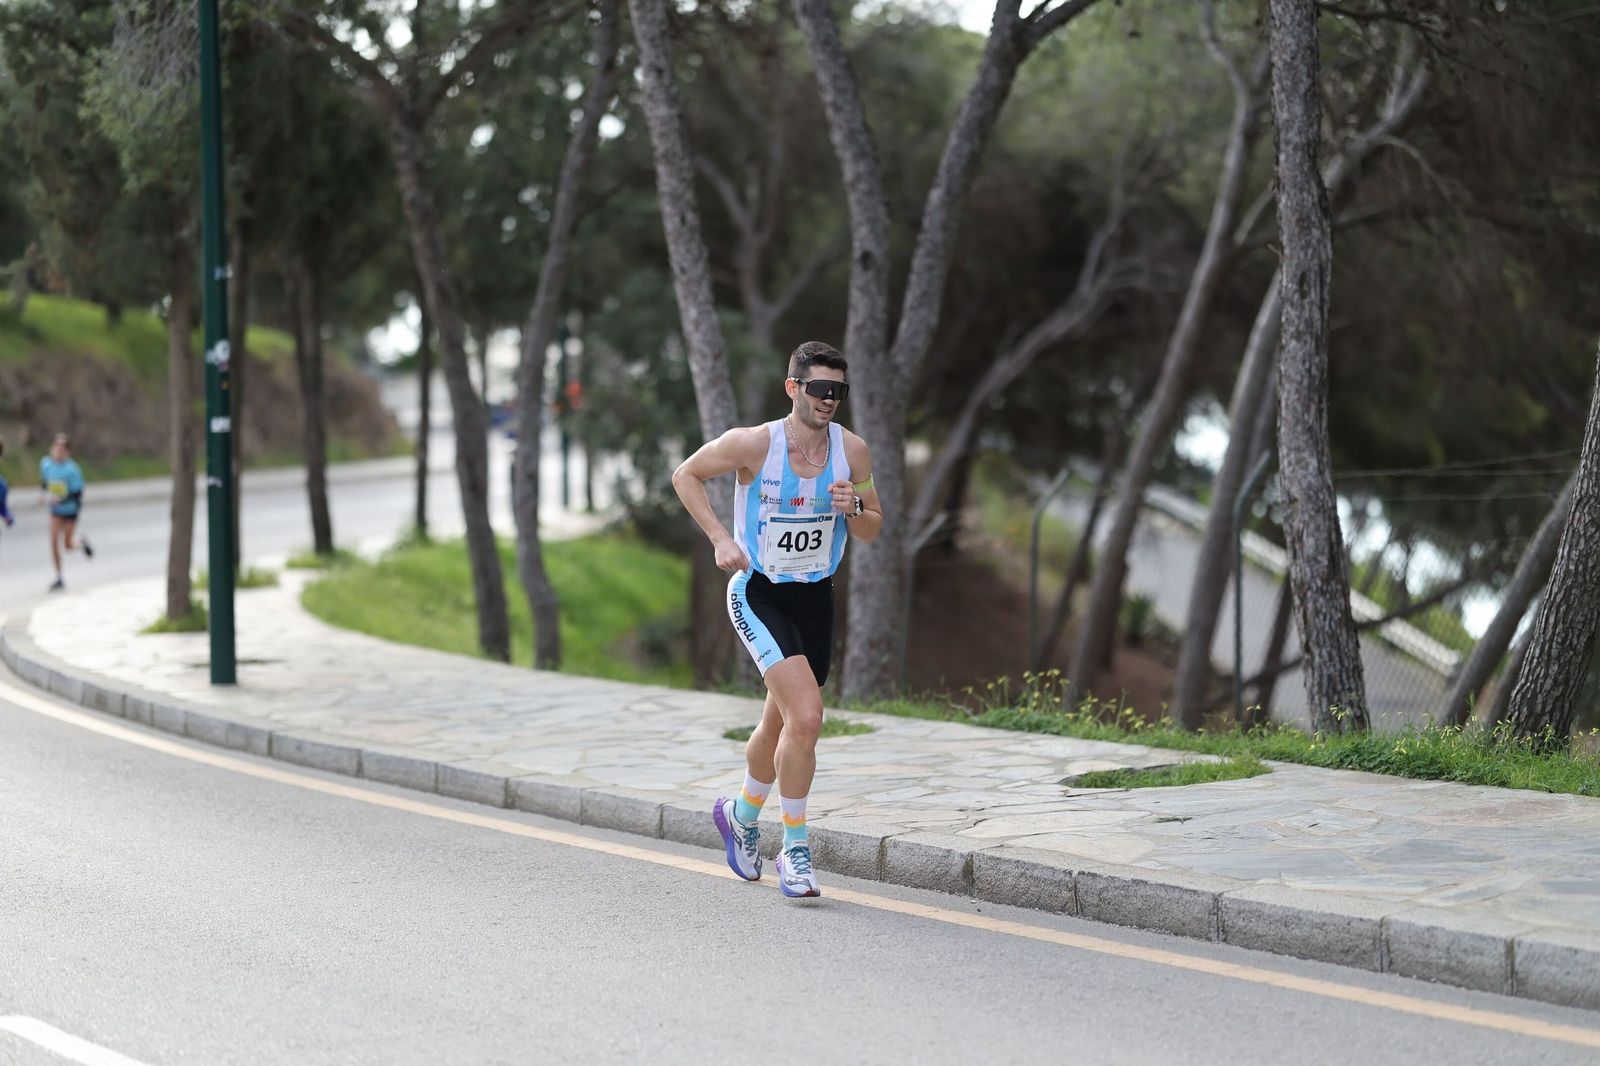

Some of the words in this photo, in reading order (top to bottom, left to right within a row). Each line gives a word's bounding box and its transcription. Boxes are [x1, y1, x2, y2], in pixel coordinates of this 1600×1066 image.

[762, 479, 780, 487] vive
[777, 529, 823, 553] 403
[731, 593, 757, 643] málaga
